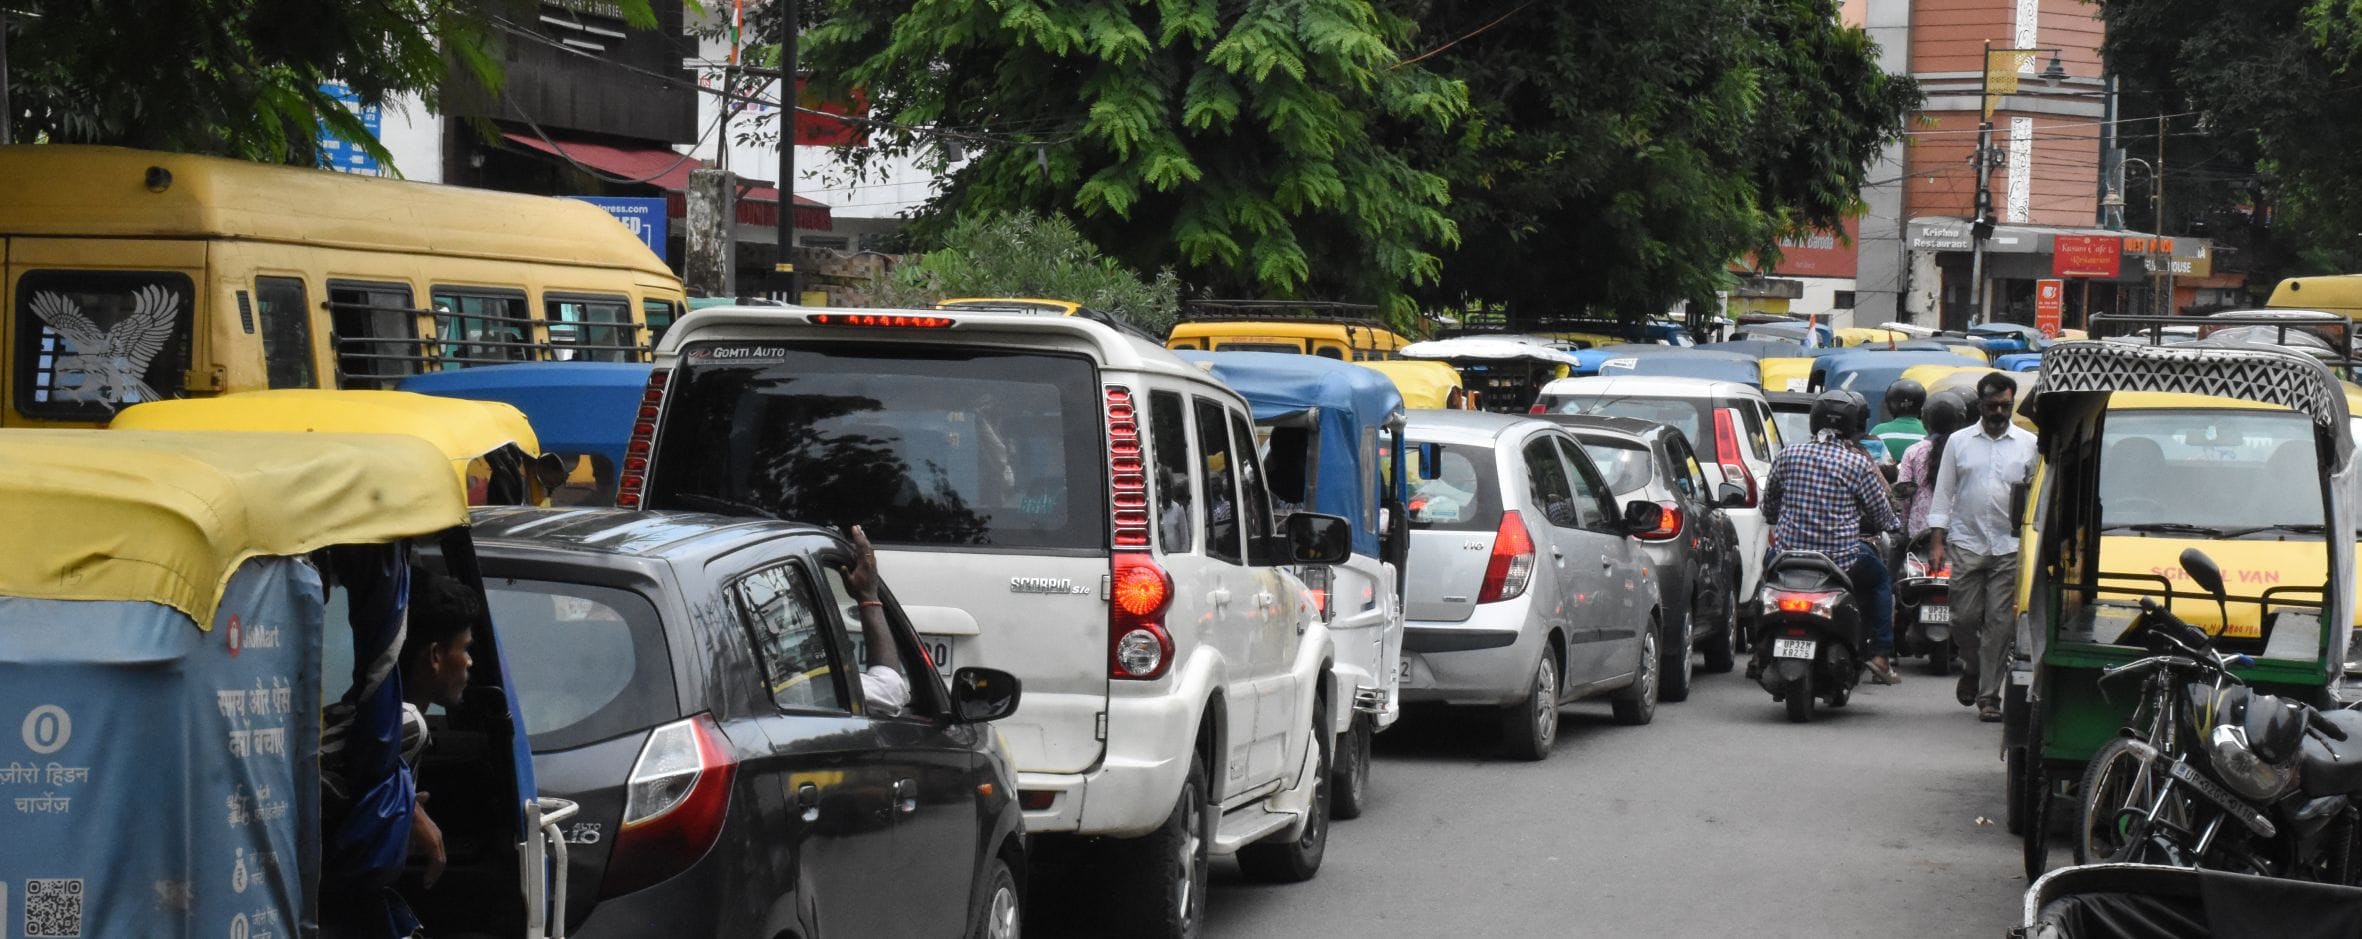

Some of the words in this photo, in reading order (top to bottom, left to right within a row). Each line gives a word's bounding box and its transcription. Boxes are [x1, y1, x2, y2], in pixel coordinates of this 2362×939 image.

[1923, 228, 1959, 237] Krishna
[1913, 238, 1968, 249] Restaurant
[713, 347, 750, 358] GOMTI
[753, 346, 785, 357] AUTO
[2151, 565, 2232, 582] SCHL
[2238, 569, 2280, 584] VAN
[1010, 577, 1071, 595] SCORPIO
[45, 762, 90, 787] हिडन
